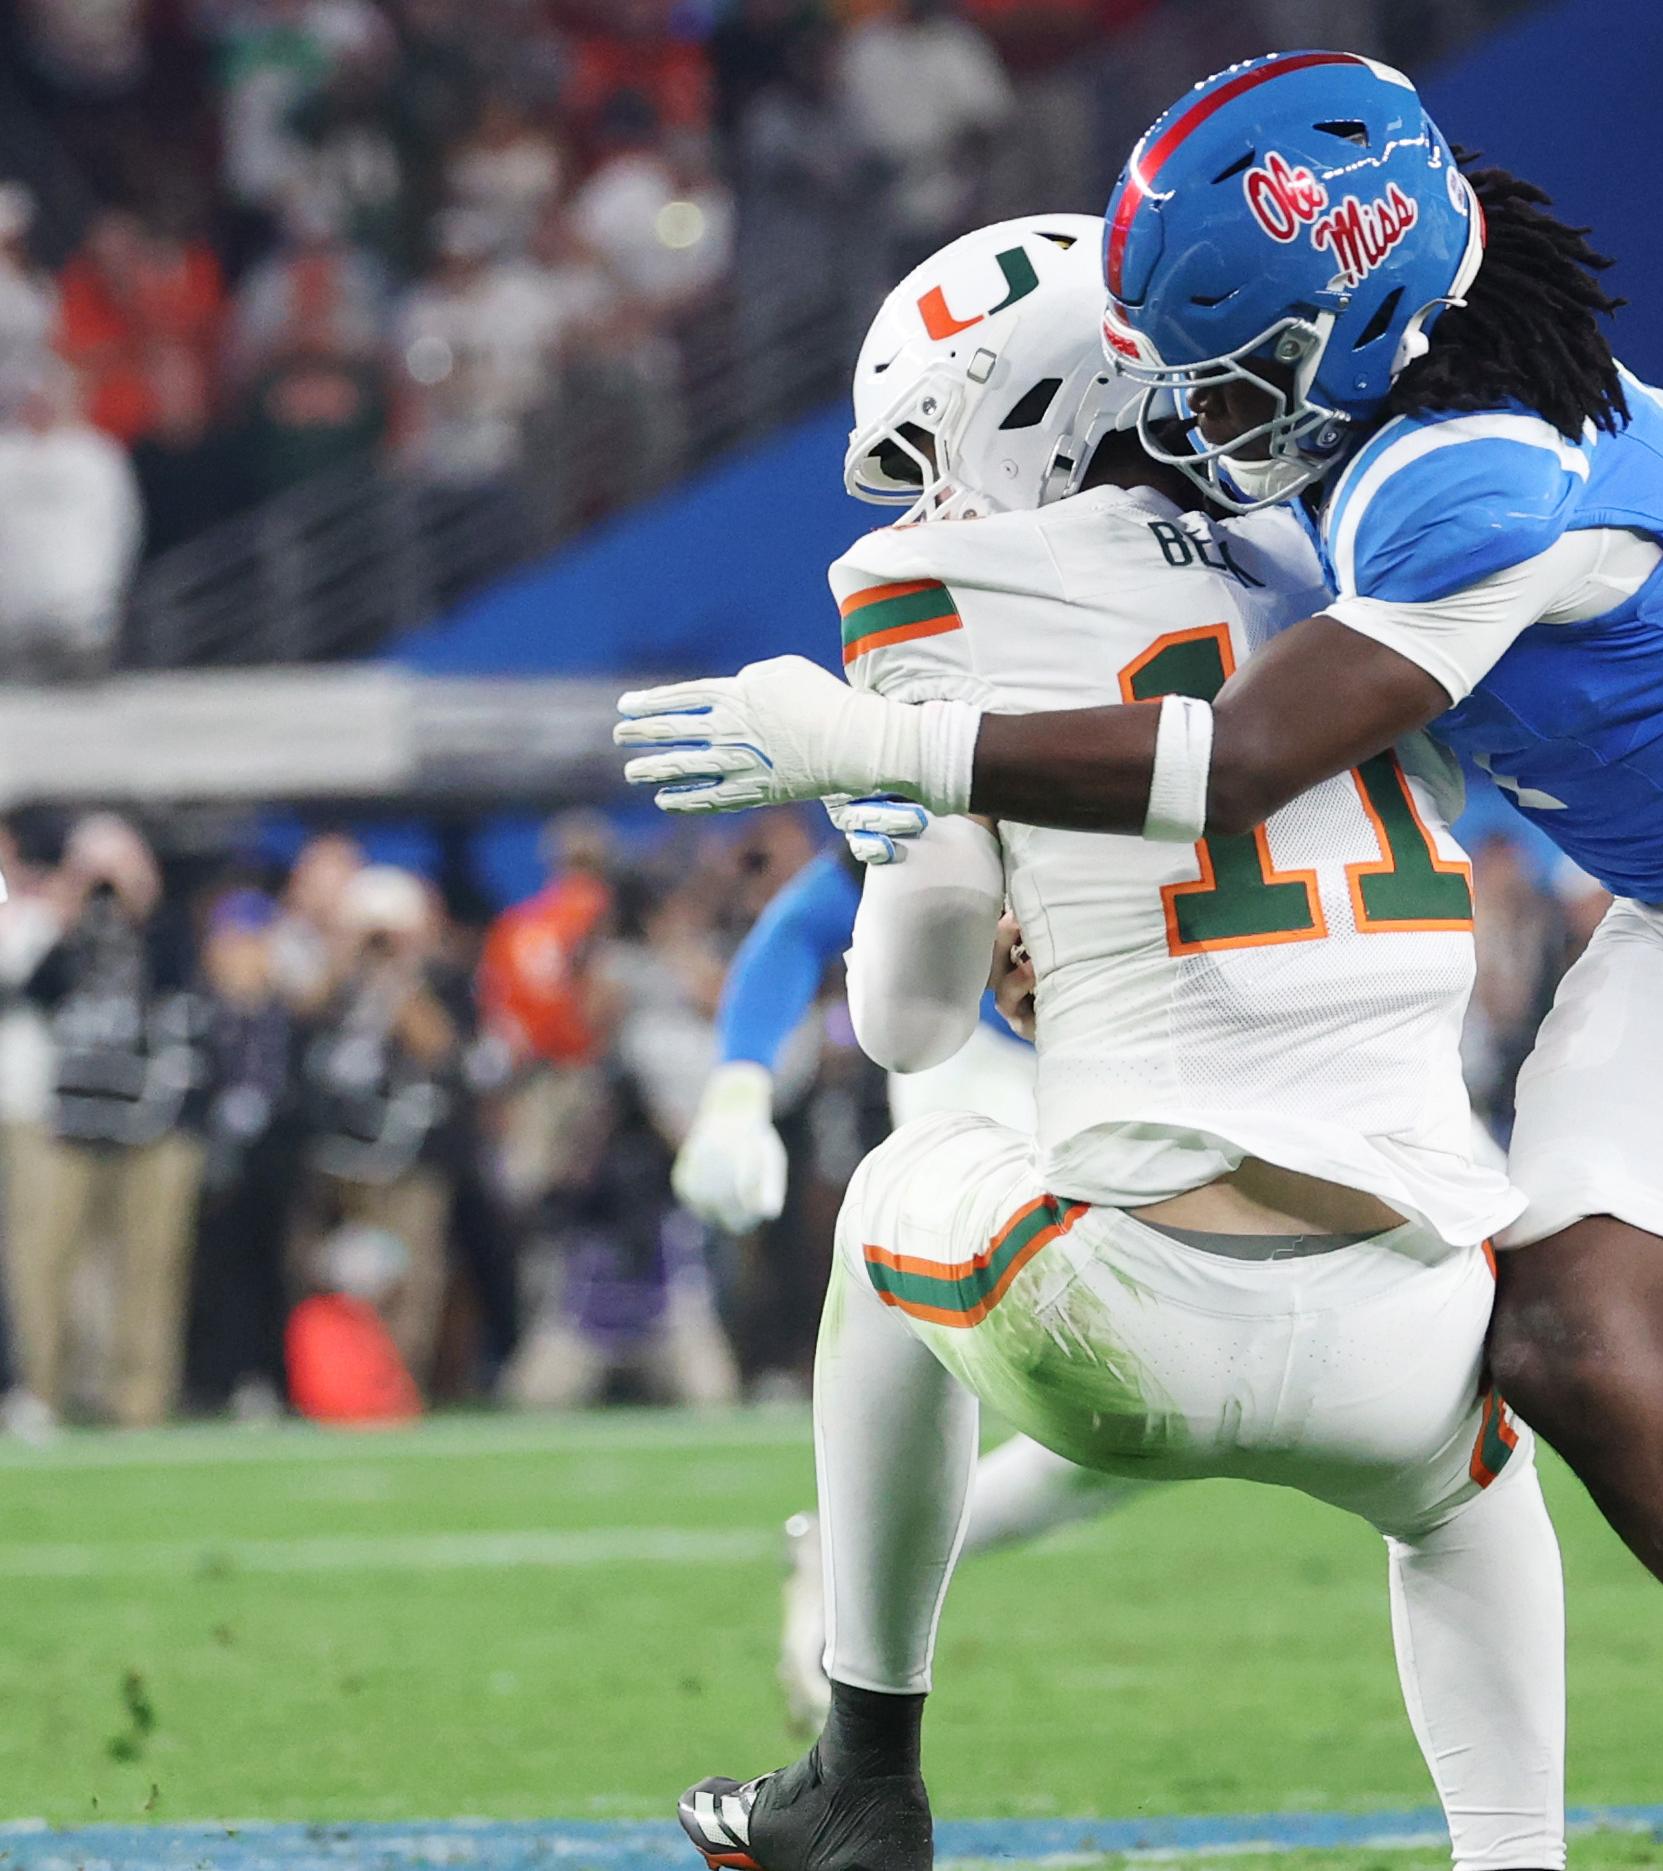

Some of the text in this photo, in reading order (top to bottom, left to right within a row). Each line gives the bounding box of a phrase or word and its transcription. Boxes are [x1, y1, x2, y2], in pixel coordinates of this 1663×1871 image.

[1244, 152, 1327, 242] Ole
[1312, 183, 1417, 287] Miss
[1117, 622, 1474, 957] 11
